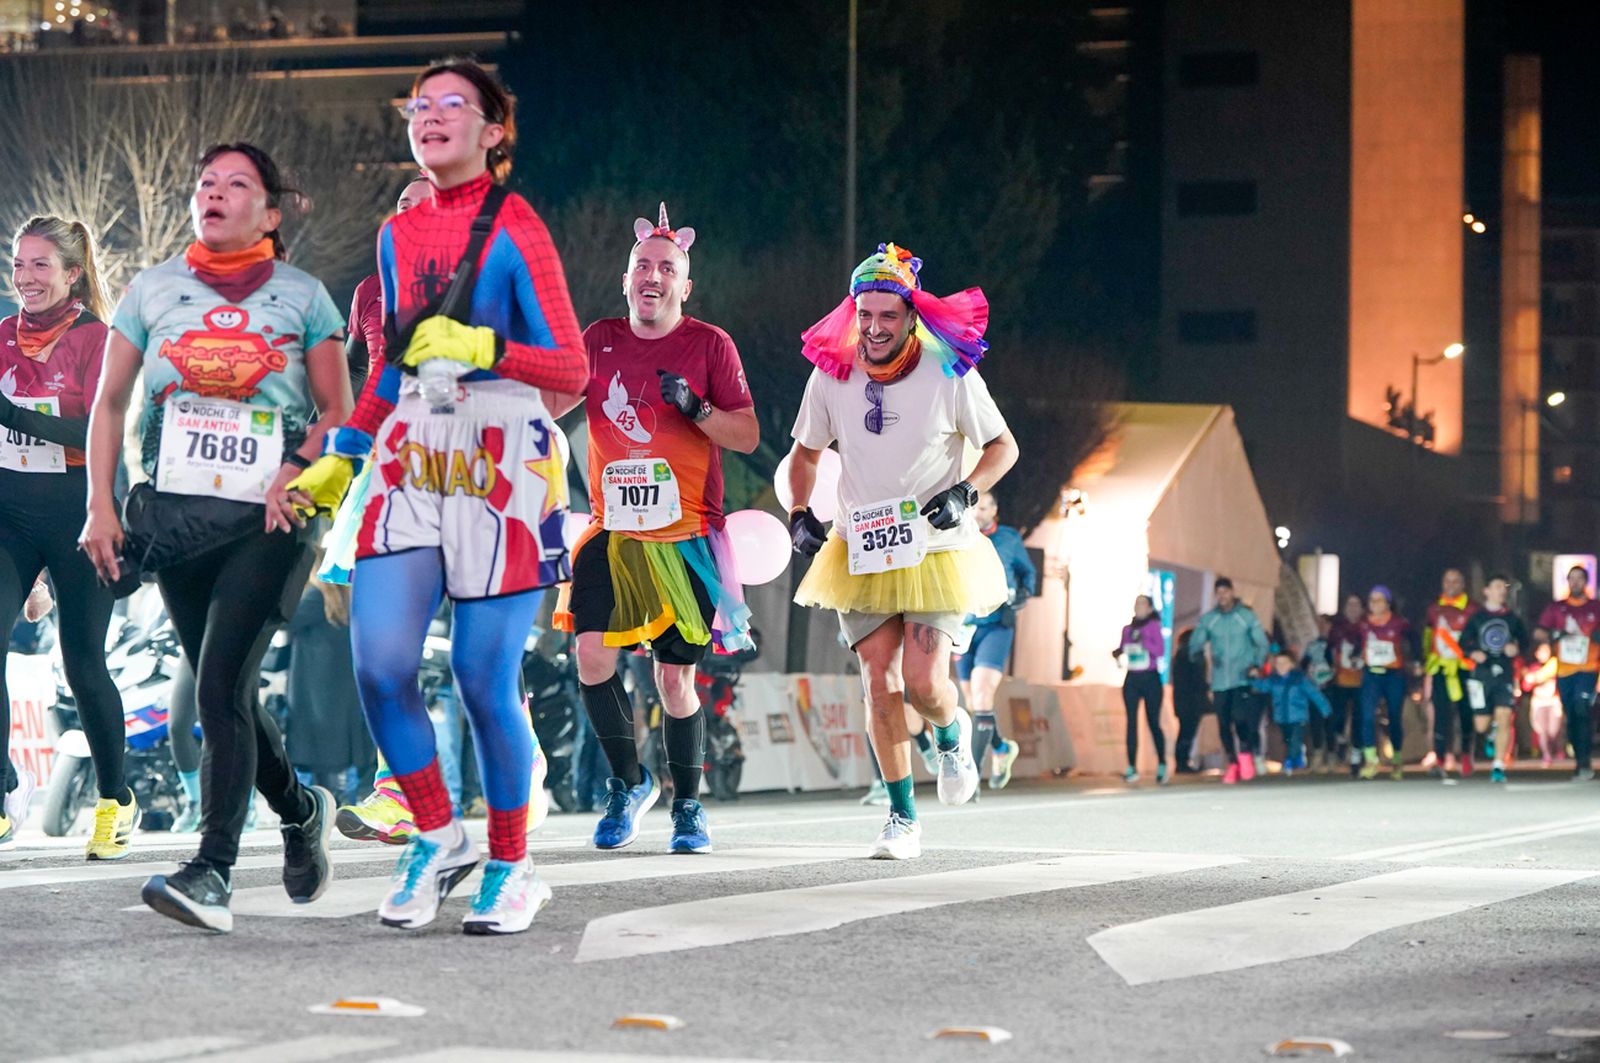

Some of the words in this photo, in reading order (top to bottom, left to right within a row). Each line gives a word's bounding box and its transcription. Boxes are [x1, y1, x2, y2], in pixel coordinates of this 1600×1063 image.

[192, 406, 225, 418] NOCHE
[229, 410, 241, 420] DE
[177, 416, 200, 428] SAN
[615, 410, 636, 431] 43
[186, 431, 259, 466] 7689
[614, 466, 637, 476] NOCHE
[637, 466, 648, 475] DE
[608, 476, 622, 484] SAN
[618, 484, 660, 507] 7077
[862, 509, 884, 520] NOCHE
[884, 506, 894, 516] DE
[855, 522, 870, 532] SAN
[862, 523, 912, 551] 3525
